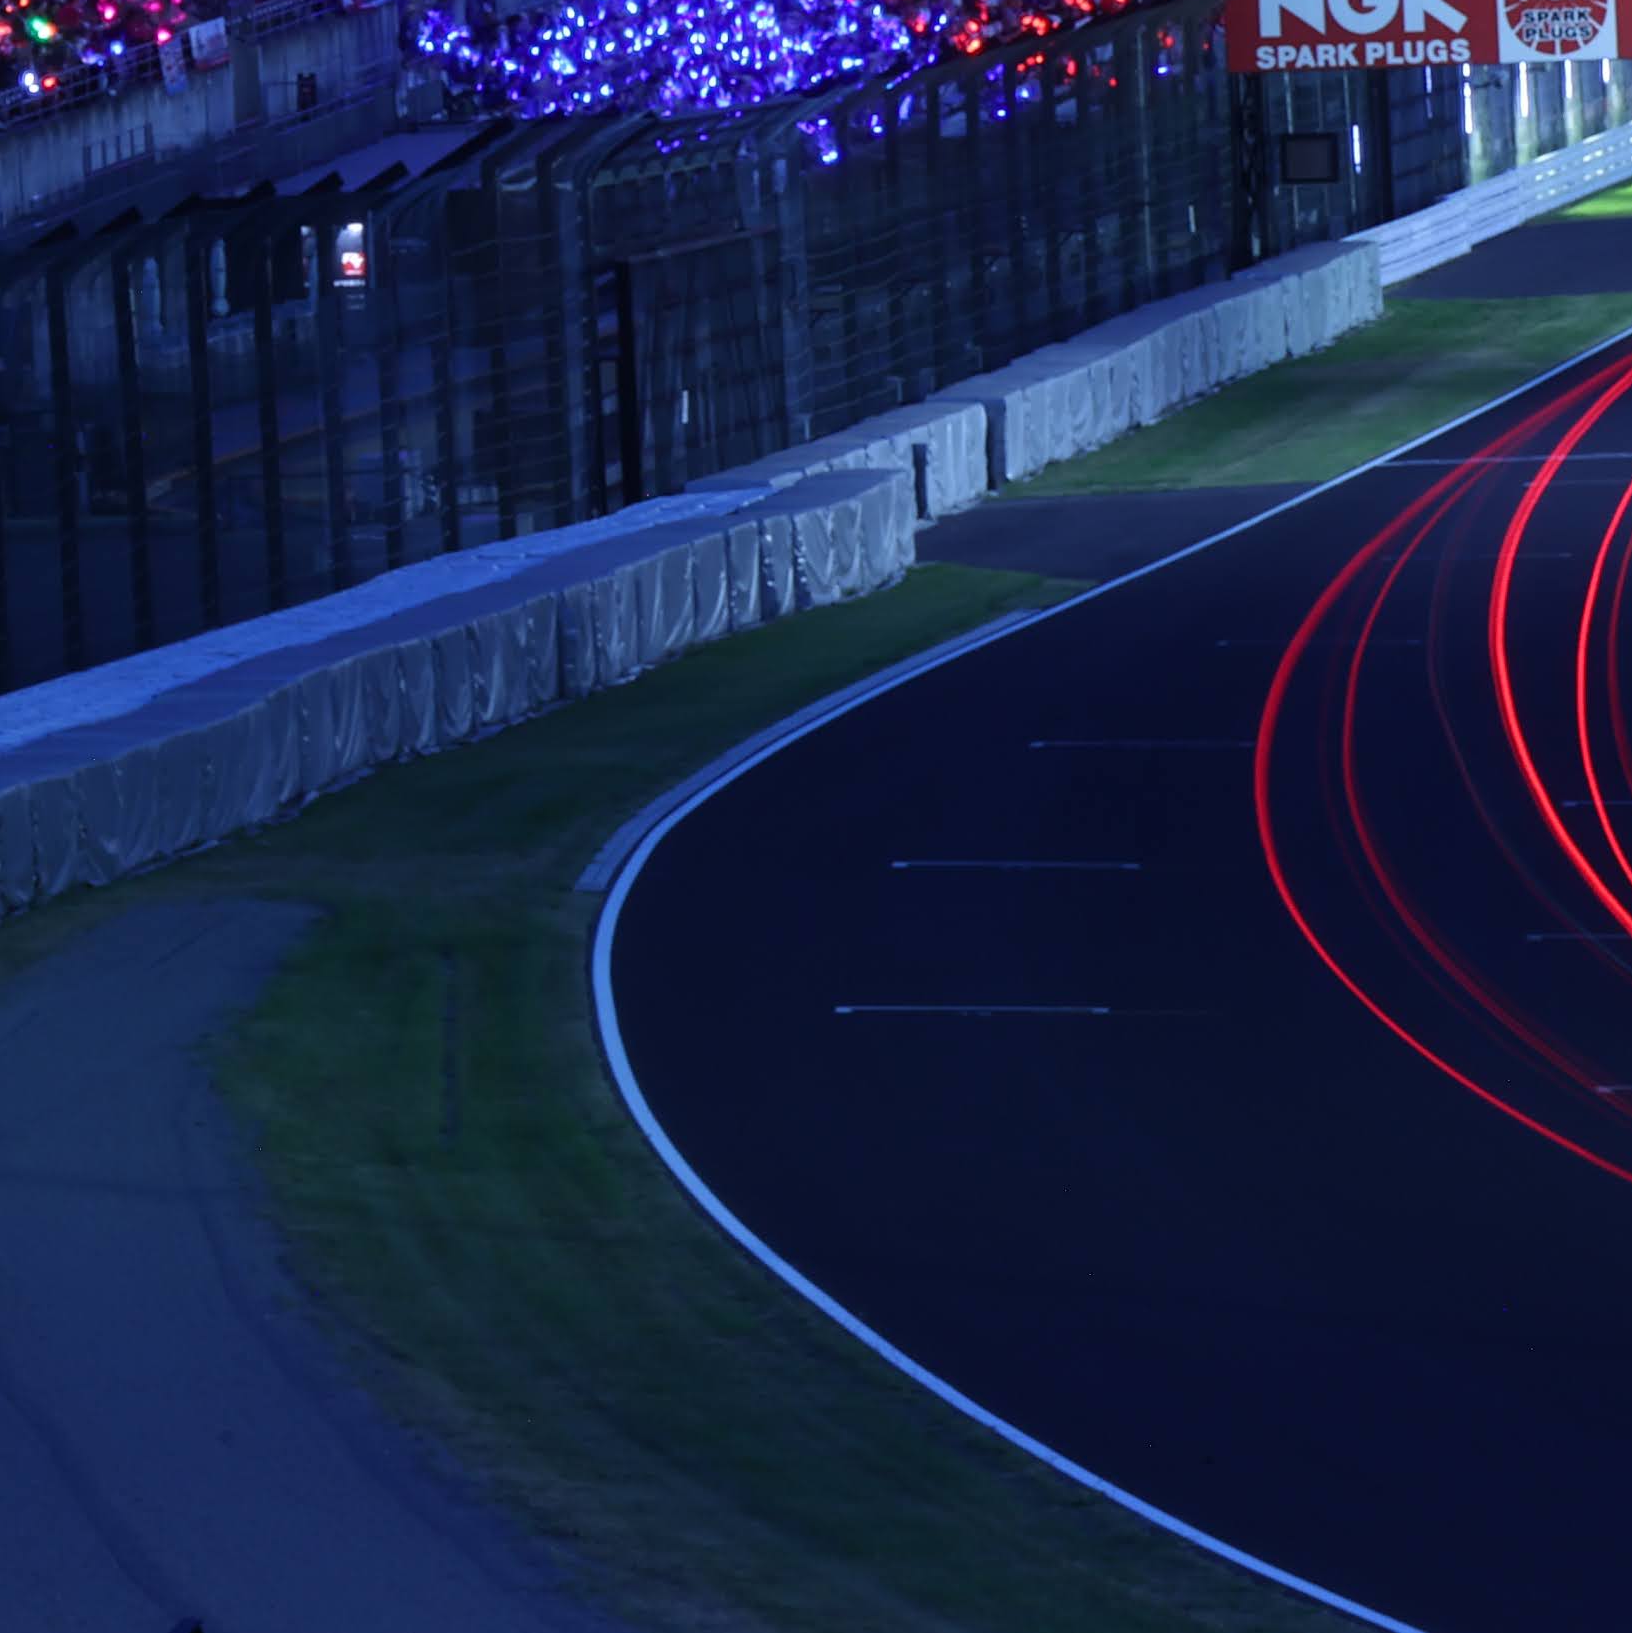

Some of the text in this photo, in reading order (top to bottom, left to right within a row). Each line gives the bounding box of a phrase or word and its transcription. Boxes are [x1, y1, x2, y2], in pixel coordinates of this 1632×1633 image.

[1524, 10, 1588, 23] SPARK
[1525, 27, 1591, 39] PLUGS
[1256, 37, 1471, 70] SPARK PLUGS
